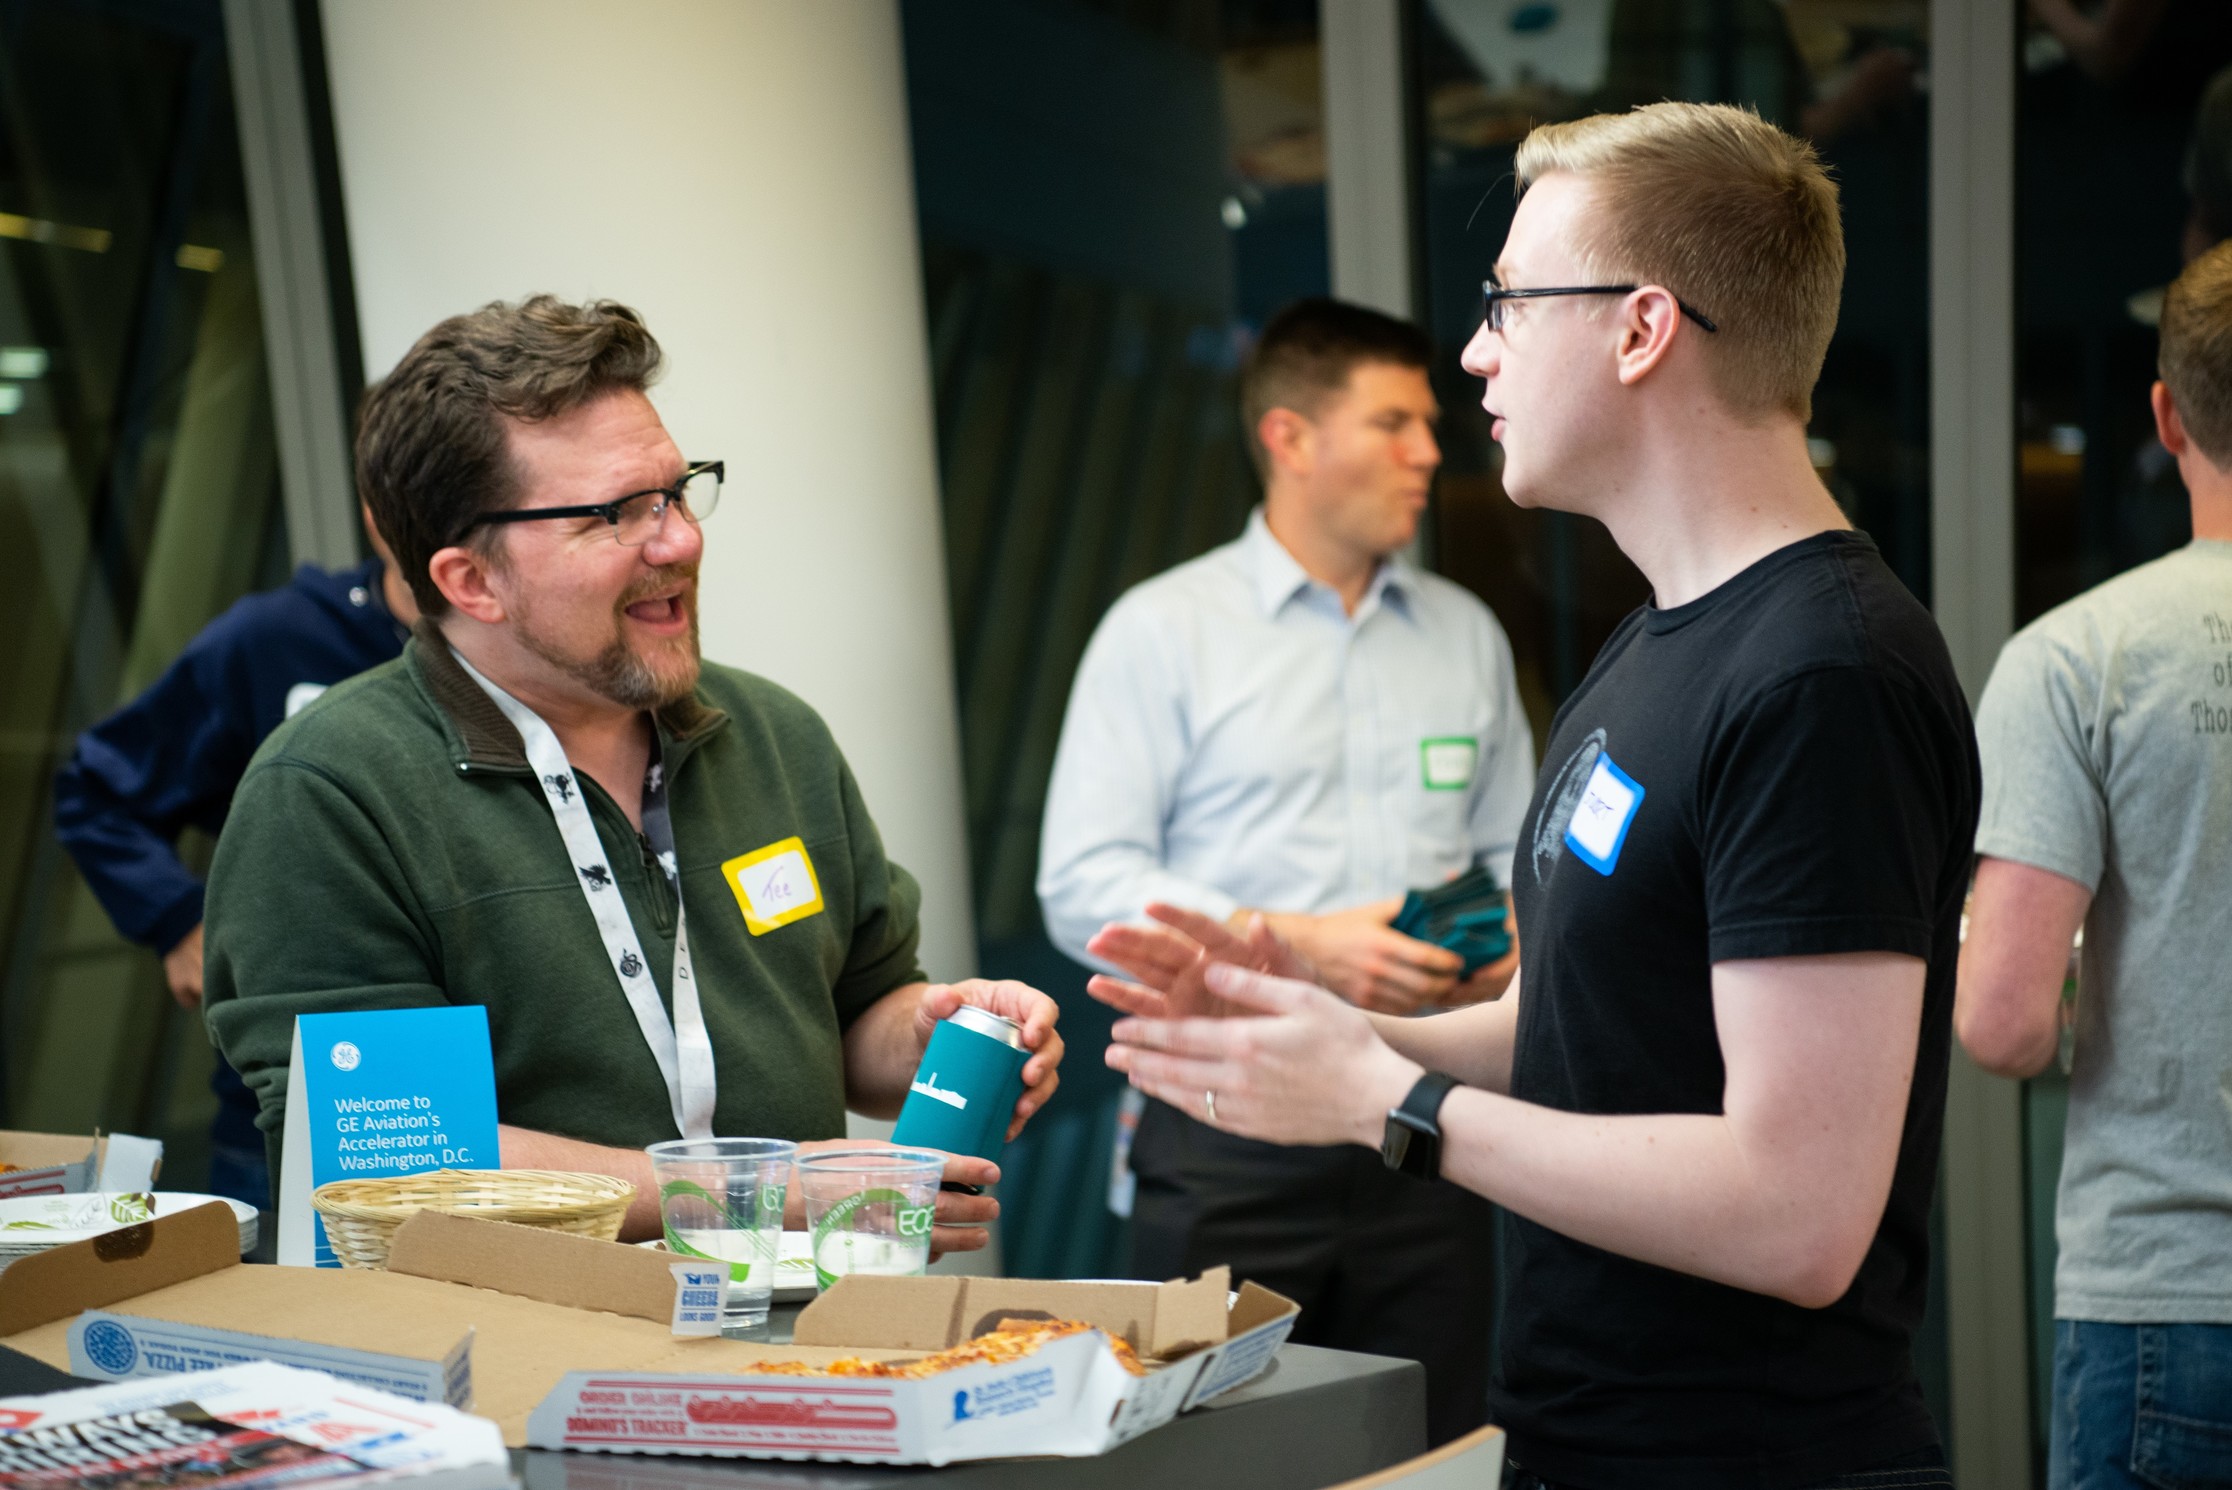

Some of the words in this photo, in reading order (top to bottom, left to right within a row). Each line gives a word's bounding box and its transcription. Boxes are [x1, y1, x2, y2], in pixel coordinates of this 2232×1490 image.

[2203, 611, 2232, 643] Th
[2190, 697, 2232, 734] Tho
[334, 1096, 410, 1114] Welcome
[413, 1095, 431, 1109] to
[336, 1117, 360, 1133] GE
[363, 1111, 441, 1131] Aviation's
[338, 1133, 430, 1152] Accelerator
[432, 1130, 448, 1145] in
[338, 1152, 440, 1171] Washington,
[442, 1147, 474, 1164] D.C.
